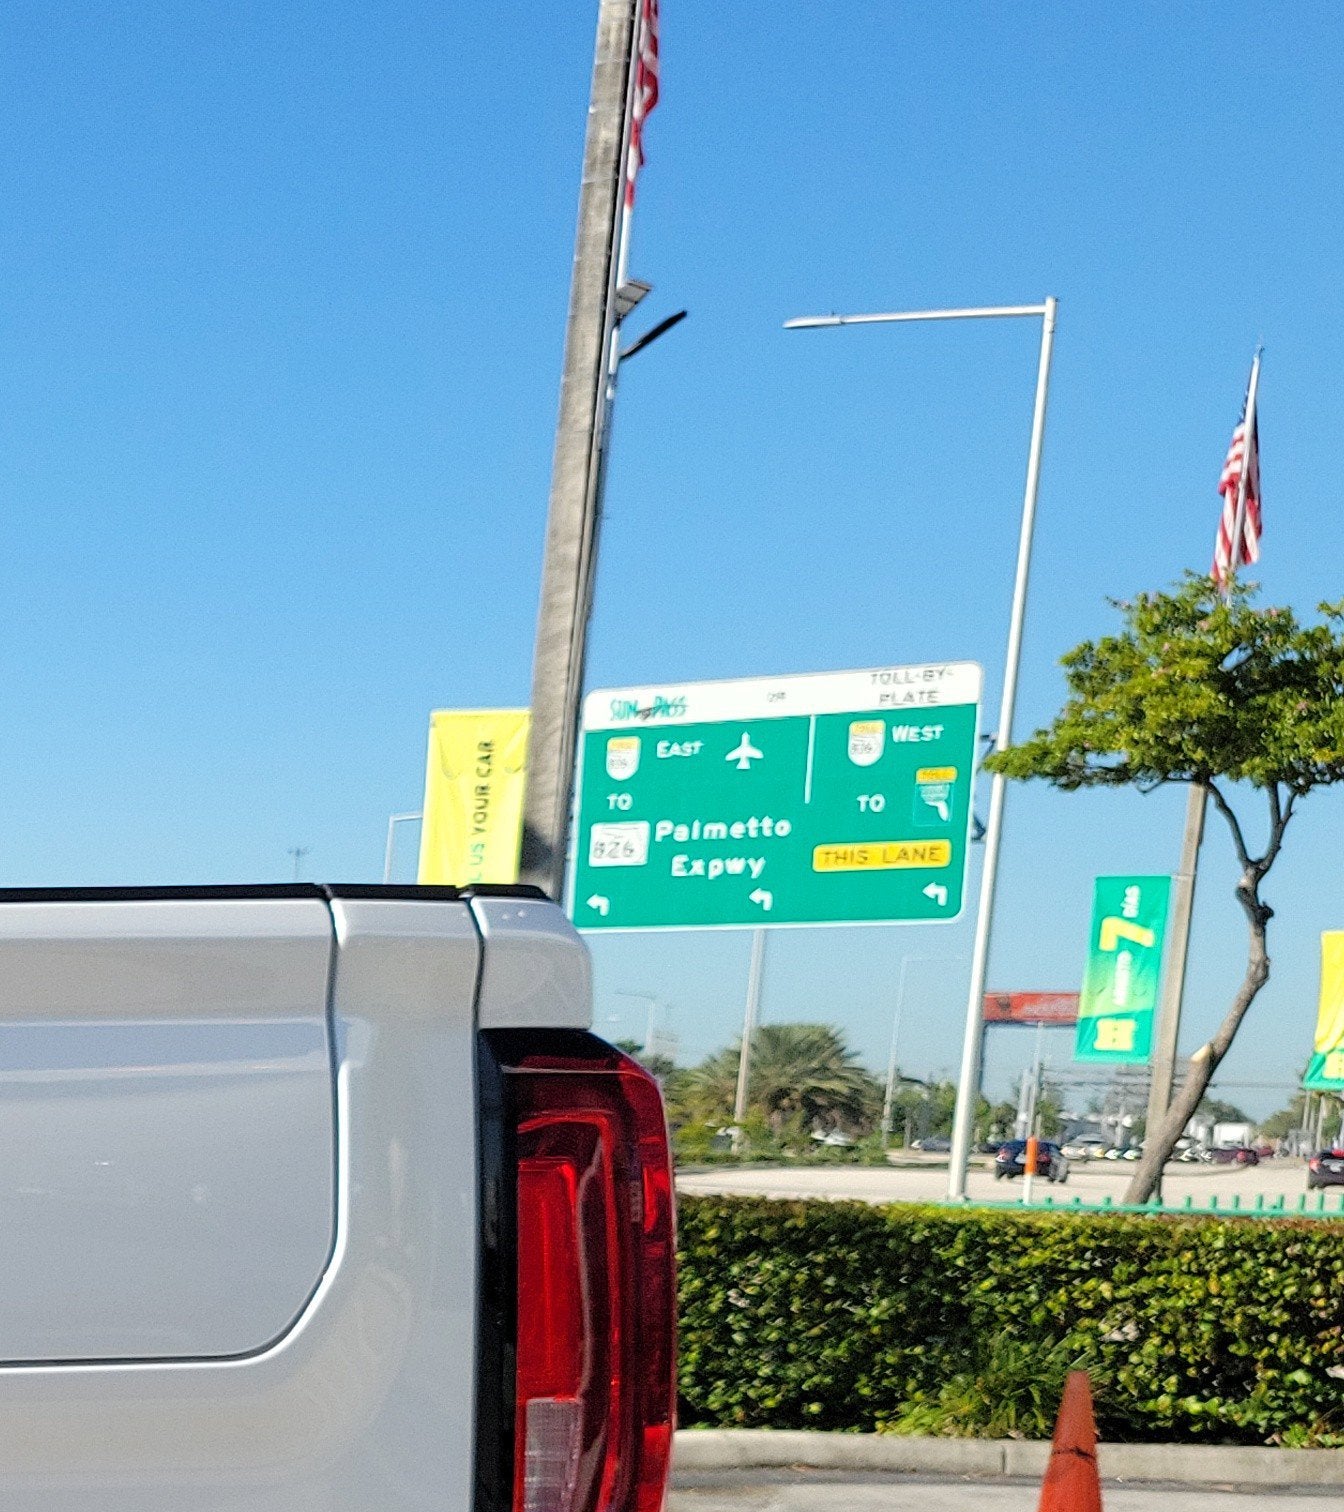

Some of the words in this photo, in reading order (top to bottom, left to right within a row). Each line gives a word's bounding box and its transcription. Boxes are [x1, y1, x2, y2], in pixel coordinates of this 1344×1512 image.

[879, 690, 940, 706] PLATE
[892, 724, 944, 743] WEST
[476, 739, 496, 779] CAR
[657, 740, 704, 759] EAST
[472, 785, 491, 836] YOUR
[607, 793, 633, 811] TO
[857, 794, 886, 813] TO
[655, 816, 792, 842] Palmetto
[470, 843, 486, 867] US
[593, 841, 635, 860] 826
[823, 849, 869, 865] THIS
[882, 846, 941, 864] LANE
[671, 854, 766, 880] Expwy
[1099, 915, 1155, 952] 7
